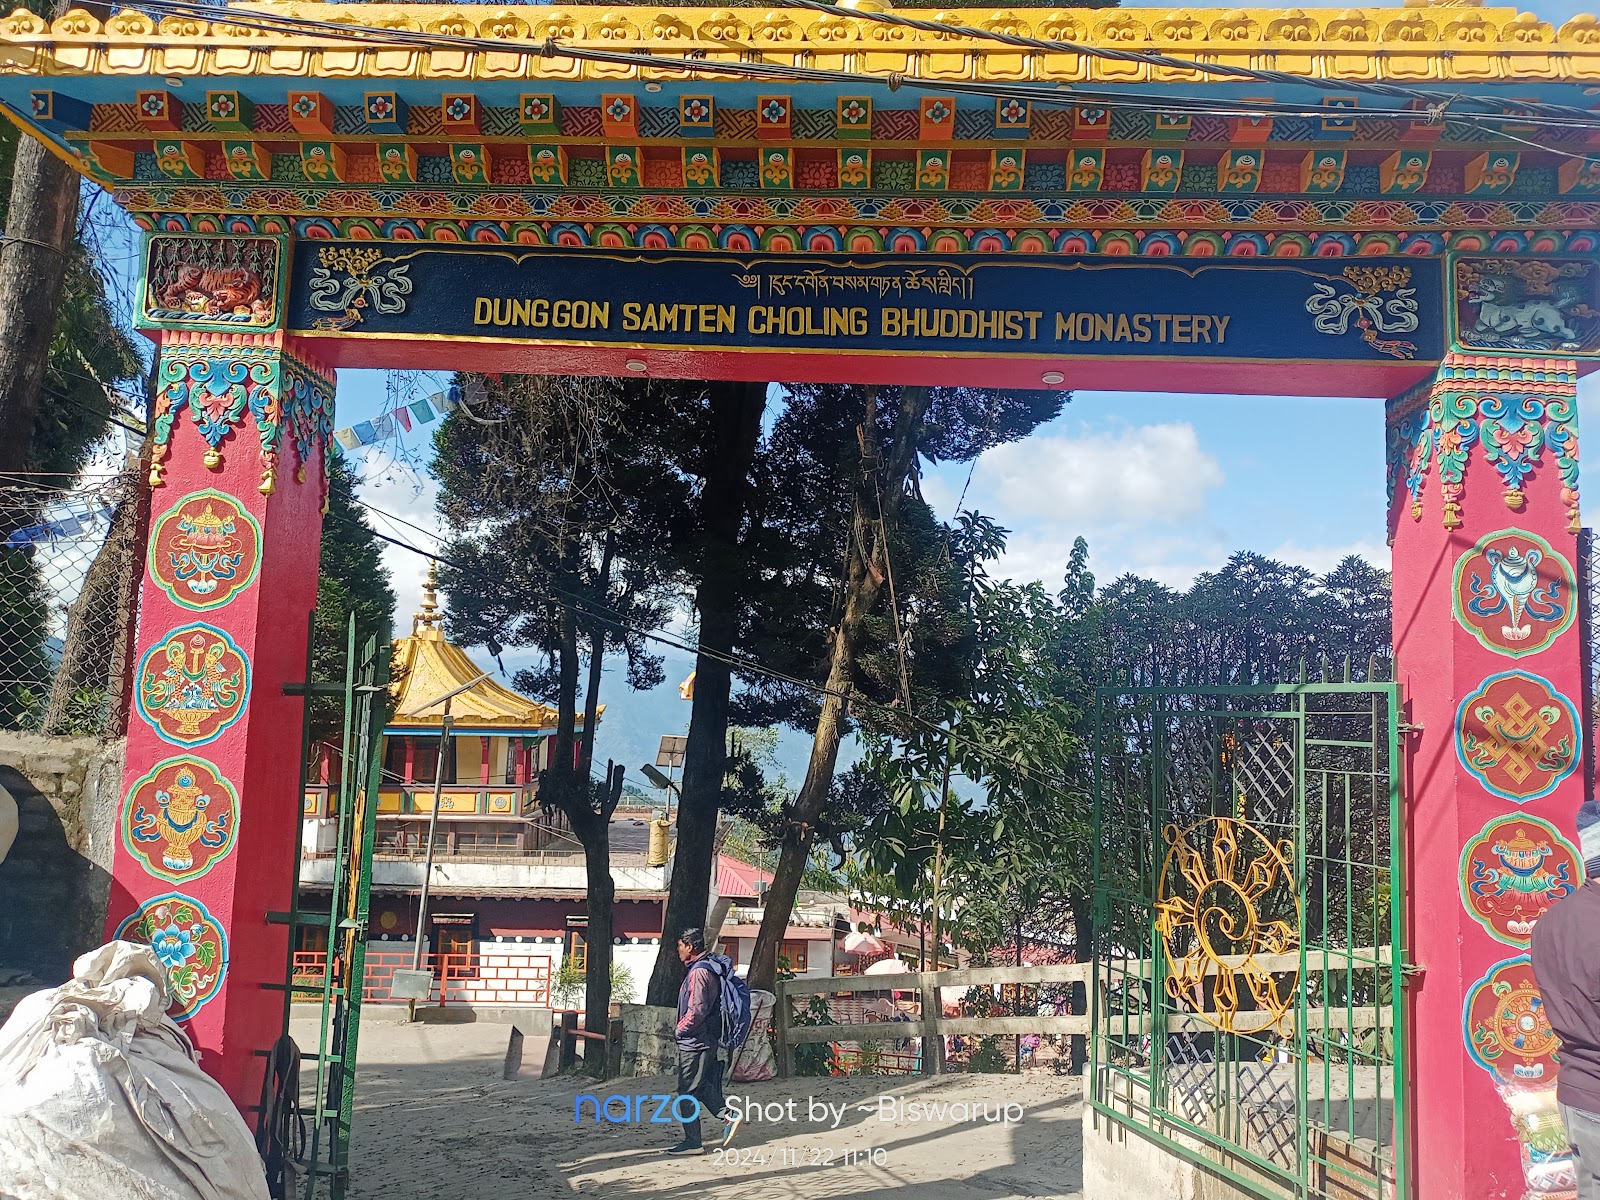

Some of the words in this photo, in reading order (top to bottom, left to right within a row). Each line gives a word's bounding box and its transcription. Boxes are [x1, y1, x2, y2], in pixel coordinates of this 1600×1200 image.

[474, 297, 609, 329] DUNGGON
[622, 302, 736, 333] SAMTEN
[747, 306, 868, 337] CHOLING
[881, 308, 1042, 340] BHUDDHIST
[1055, 312, 1231, 344] MONASTERY
